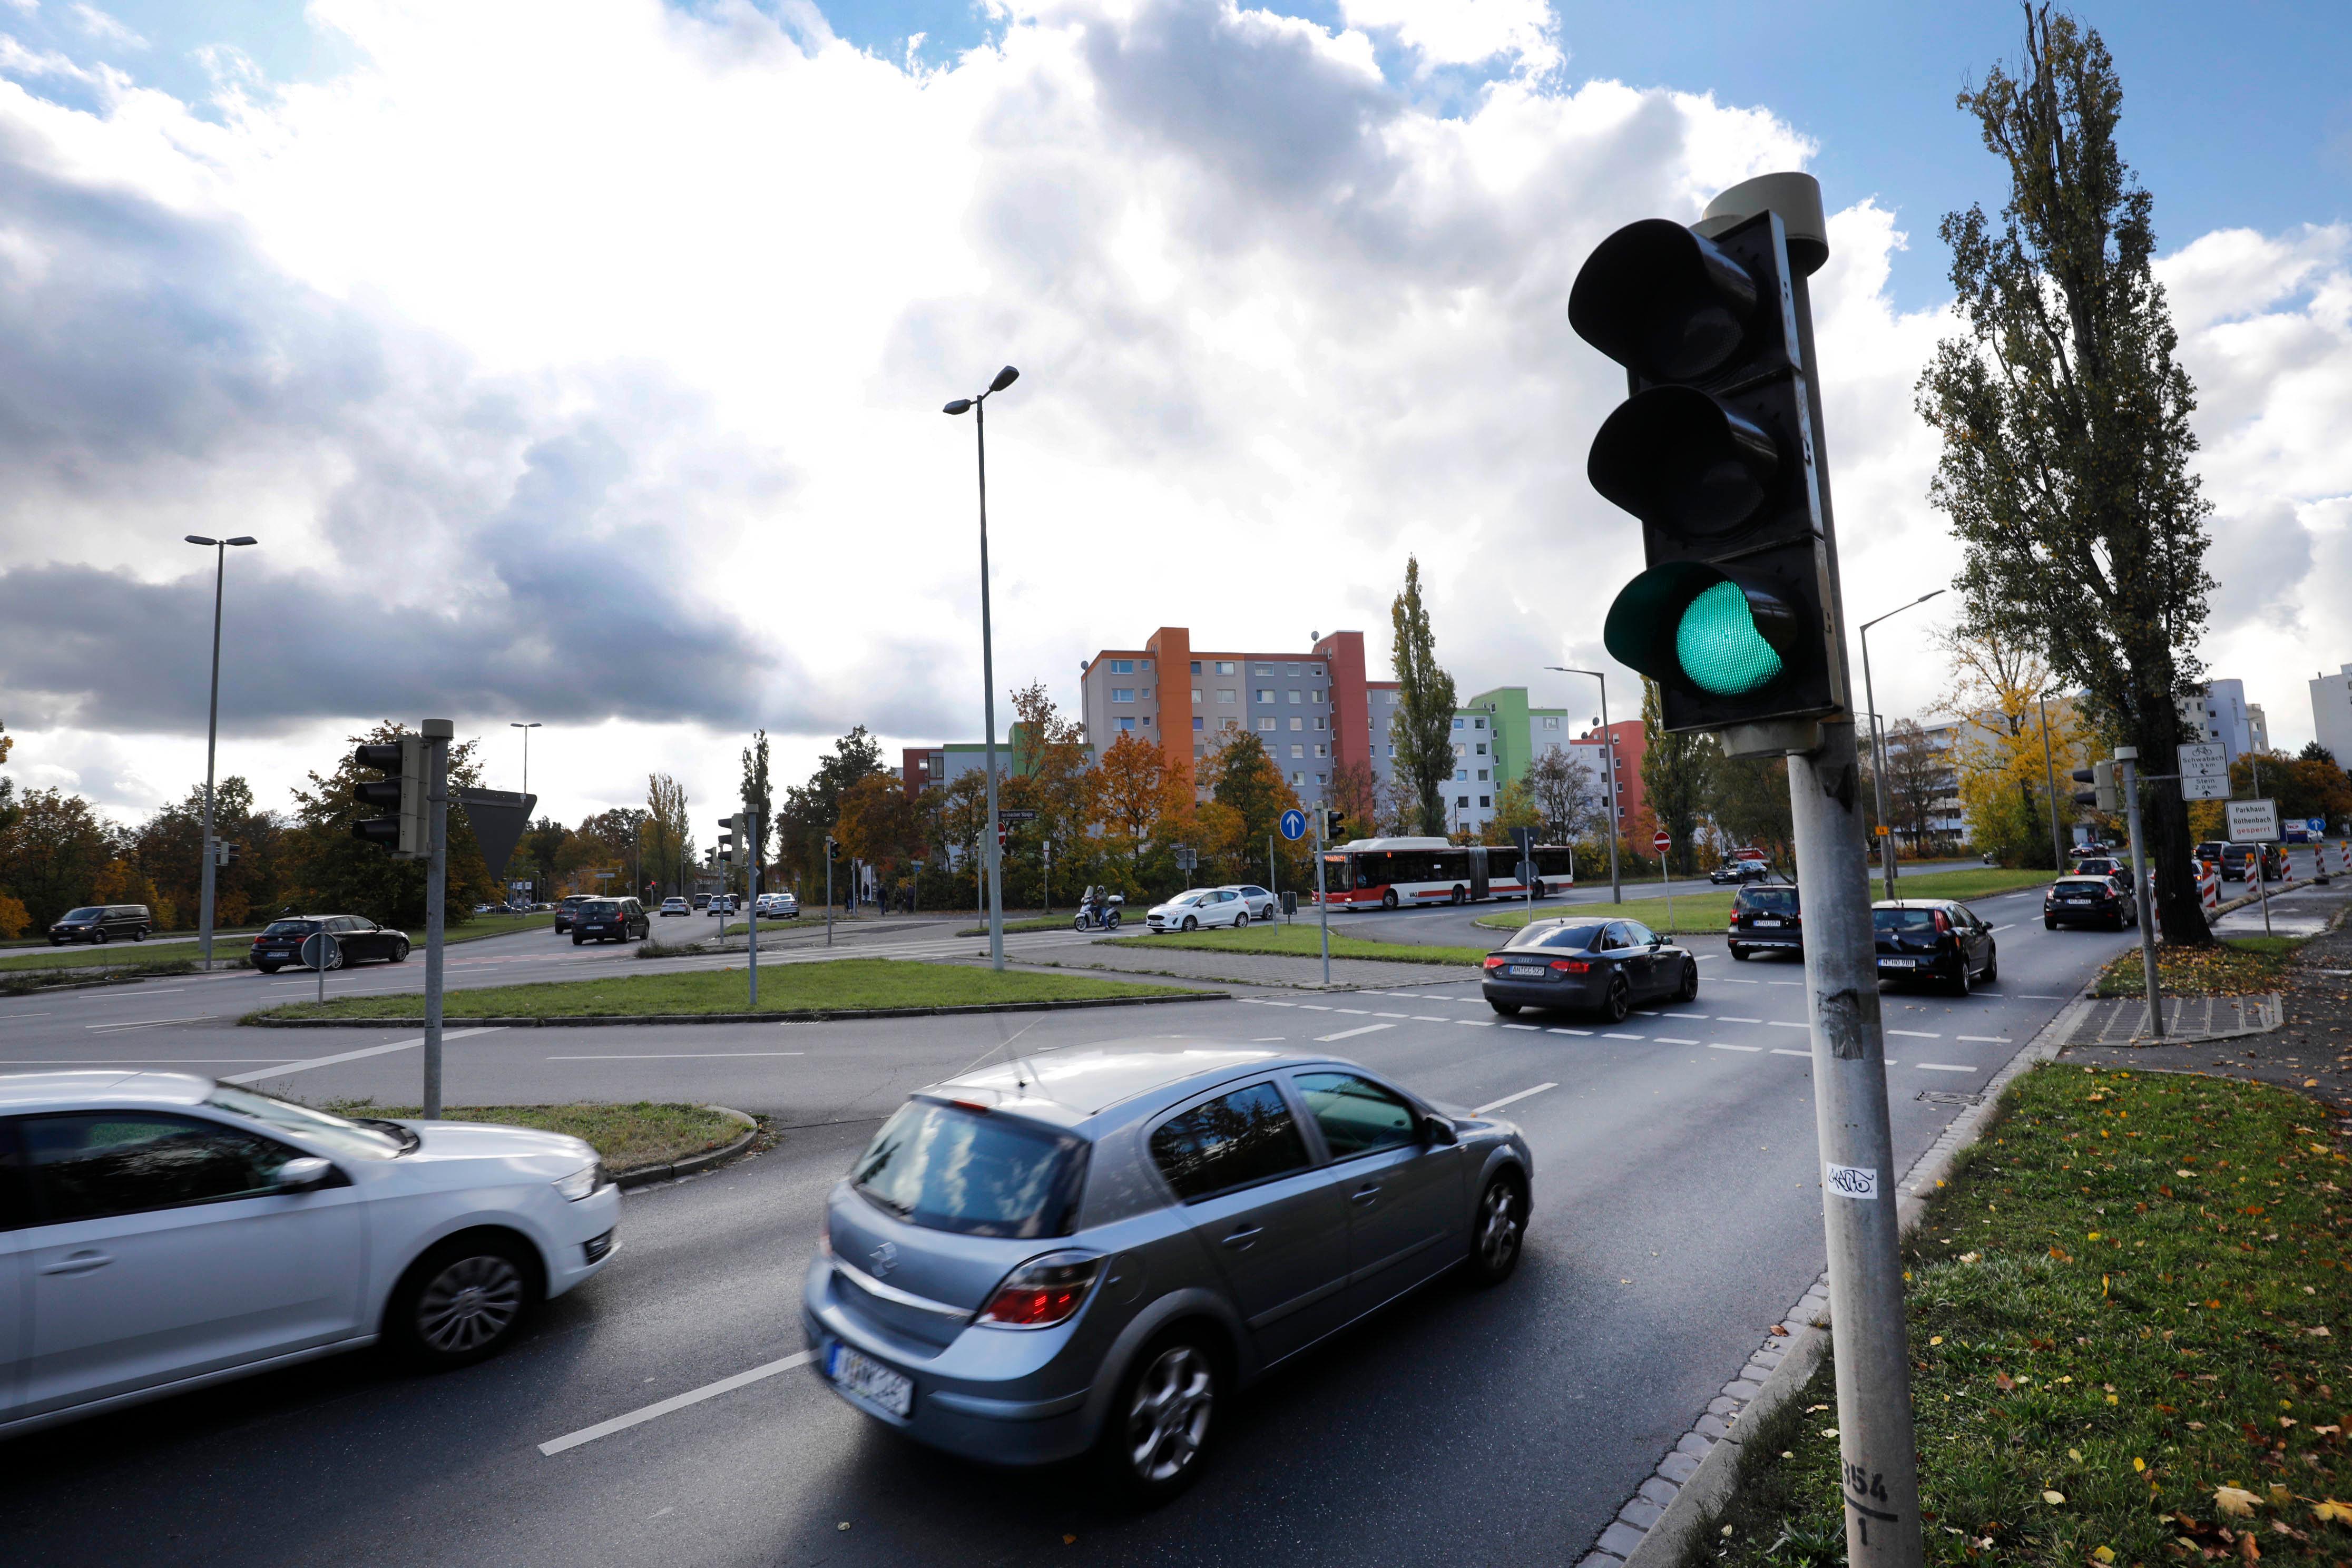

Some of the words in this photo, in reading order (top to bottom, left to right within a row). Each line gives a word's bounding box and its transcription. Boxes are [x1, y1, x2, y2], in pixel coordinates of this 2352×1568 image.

[2233, 816, 2271, 825] Röthenbach
[2236, 826, 2271, 835] gesperrt
[1858, 1517, 1868, 1546] 1
